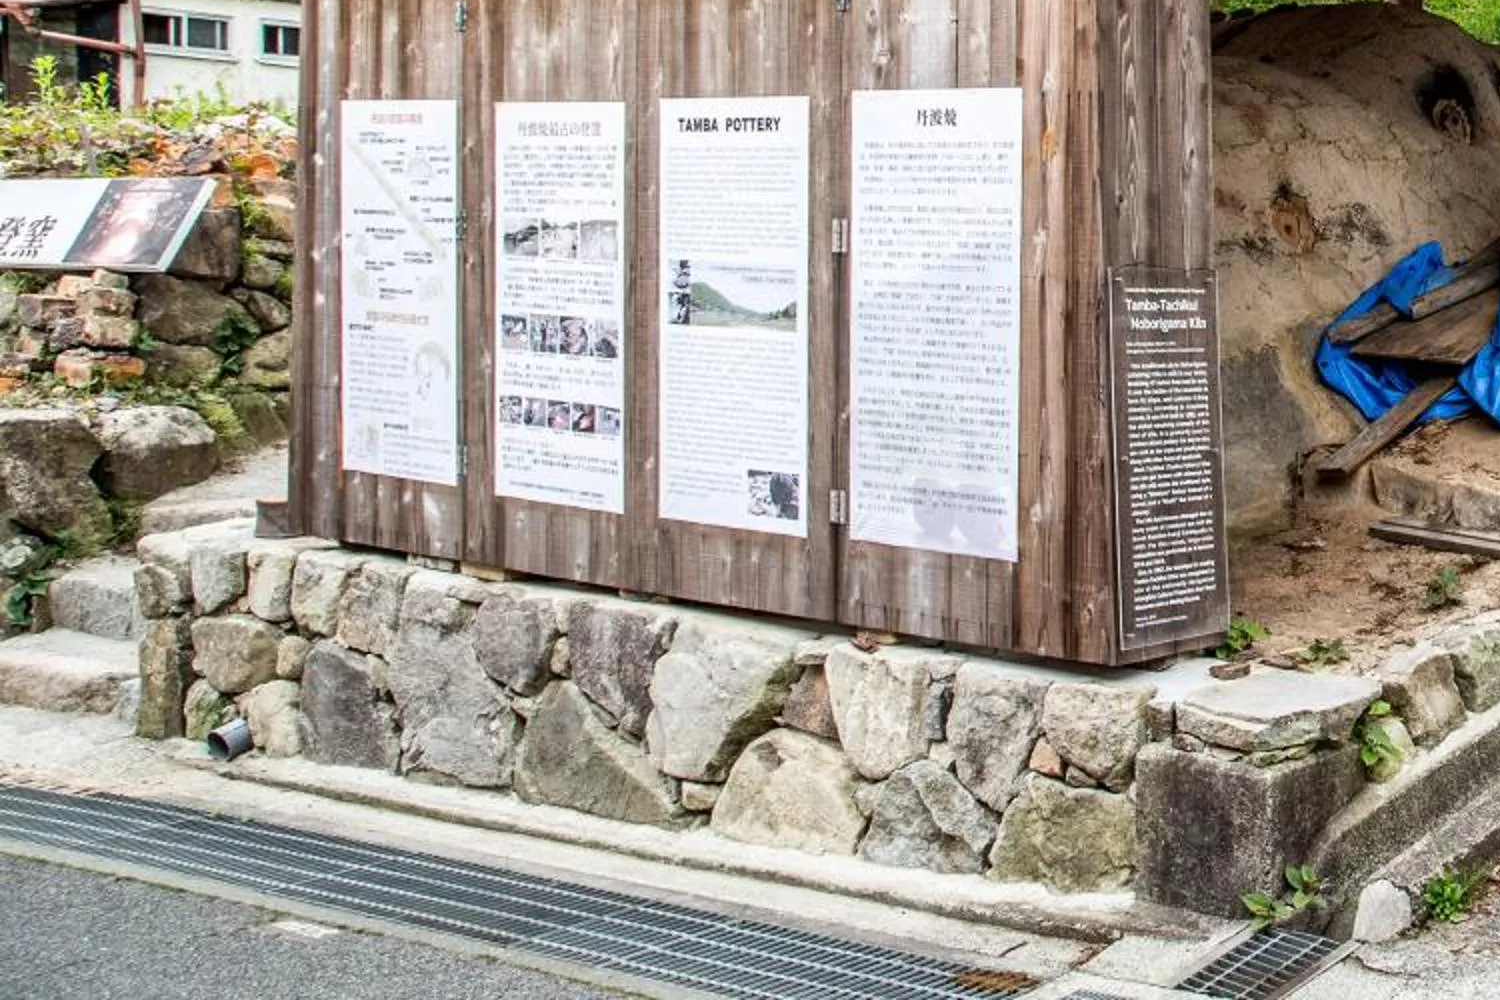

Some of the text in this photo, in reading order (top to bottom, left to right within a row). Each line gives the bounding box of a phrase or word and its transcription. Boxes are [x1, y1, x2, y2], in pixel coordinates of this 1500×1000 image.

[678, 116, 781, 133] TAMBA POTTERY
[1189, 317, 1207, 329] Kiln
